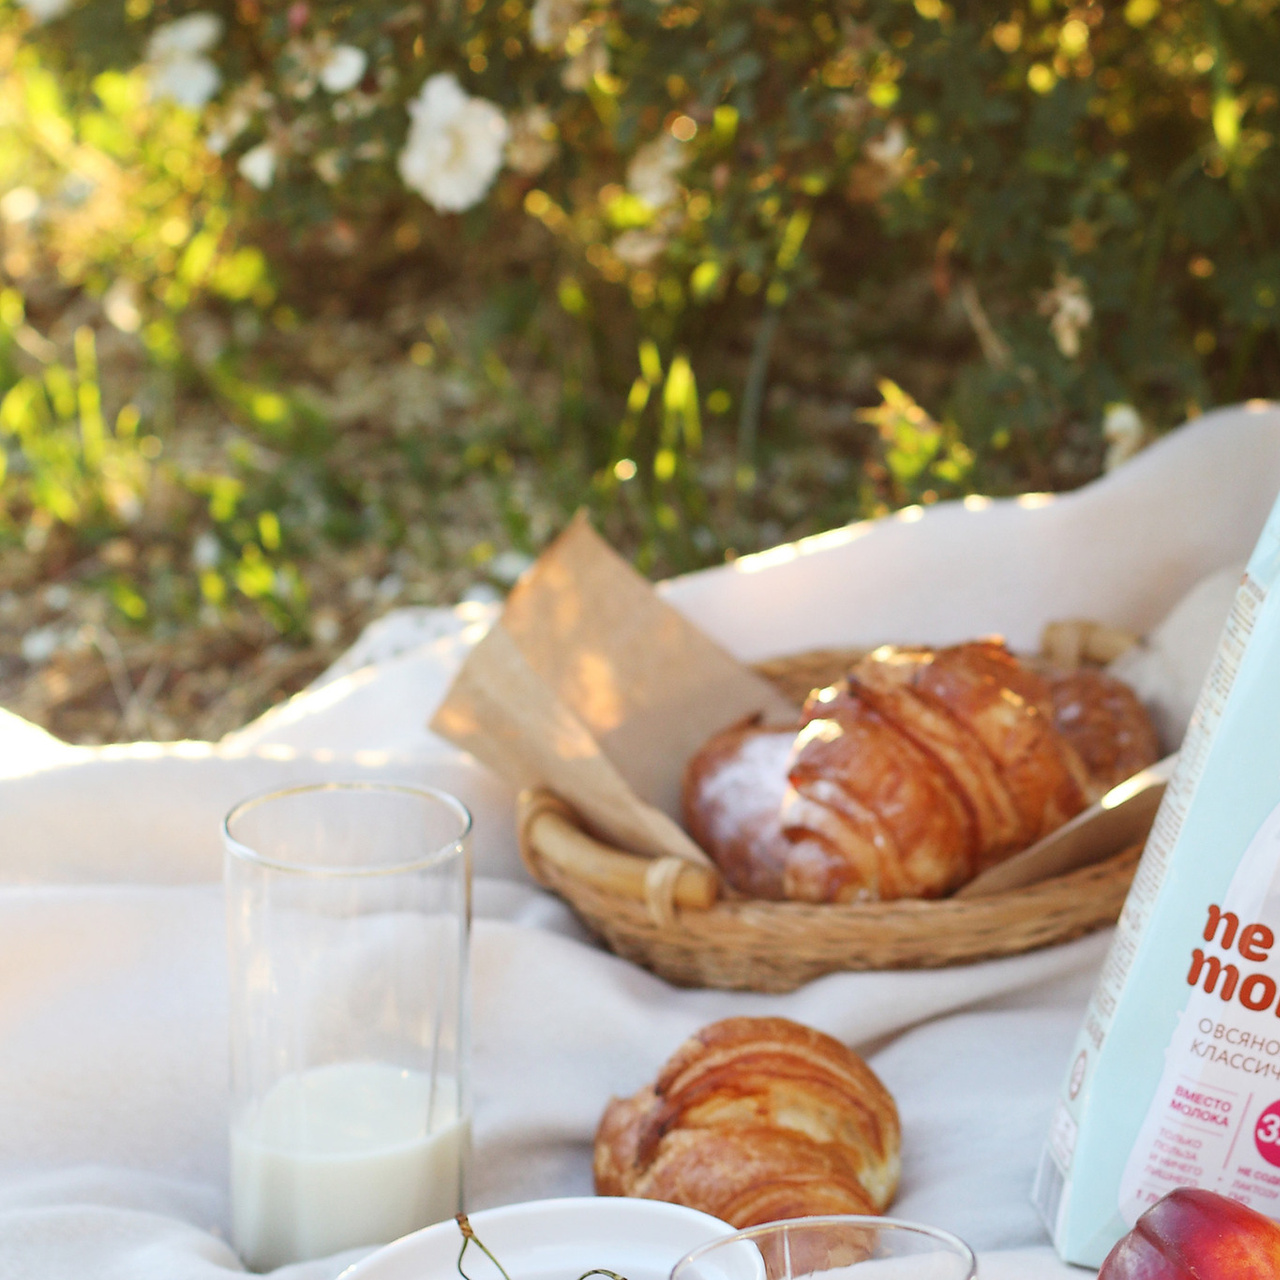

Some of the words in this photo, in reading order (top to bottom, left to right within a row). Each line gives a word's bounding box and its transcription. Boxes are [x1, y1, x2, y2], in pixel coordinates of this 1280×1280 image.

[1203, 904, 1275, 962] ne
[1169, 1099, 1230, 1128] МОЛОКА
[1174, 1085, 1233, 1113] ВМЕСТО
